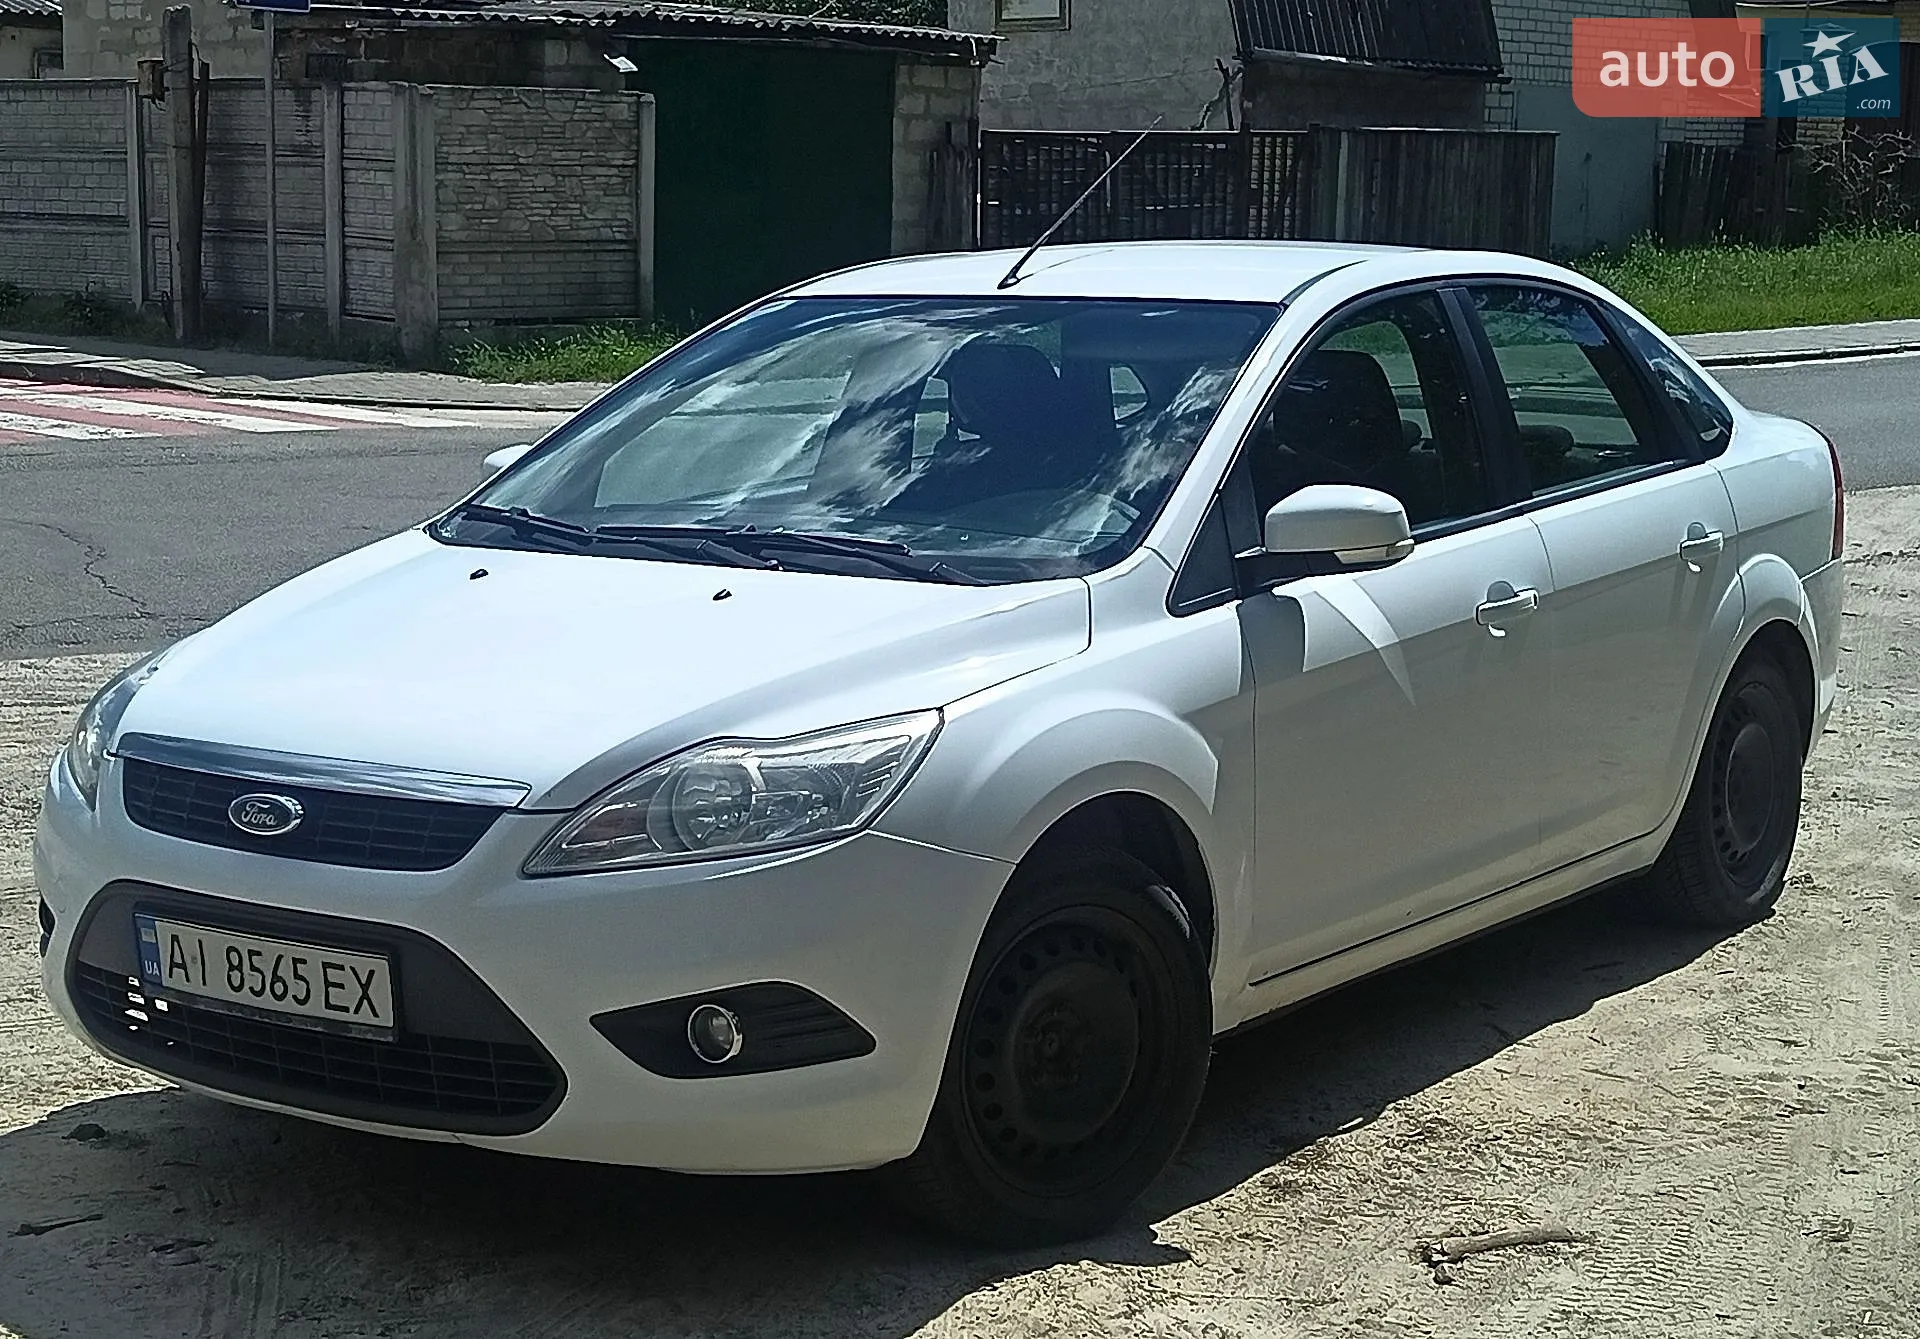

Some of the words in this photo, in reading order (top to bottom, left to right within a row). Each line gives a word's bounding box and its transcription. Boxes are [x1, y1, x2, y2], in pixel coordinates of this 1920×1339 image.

[144, 960, 160, 977] UA
[168, 934, 207, 986] AI
[225, 946, 311, 1006] 8565
[322, 960, 380, 1018] EX
